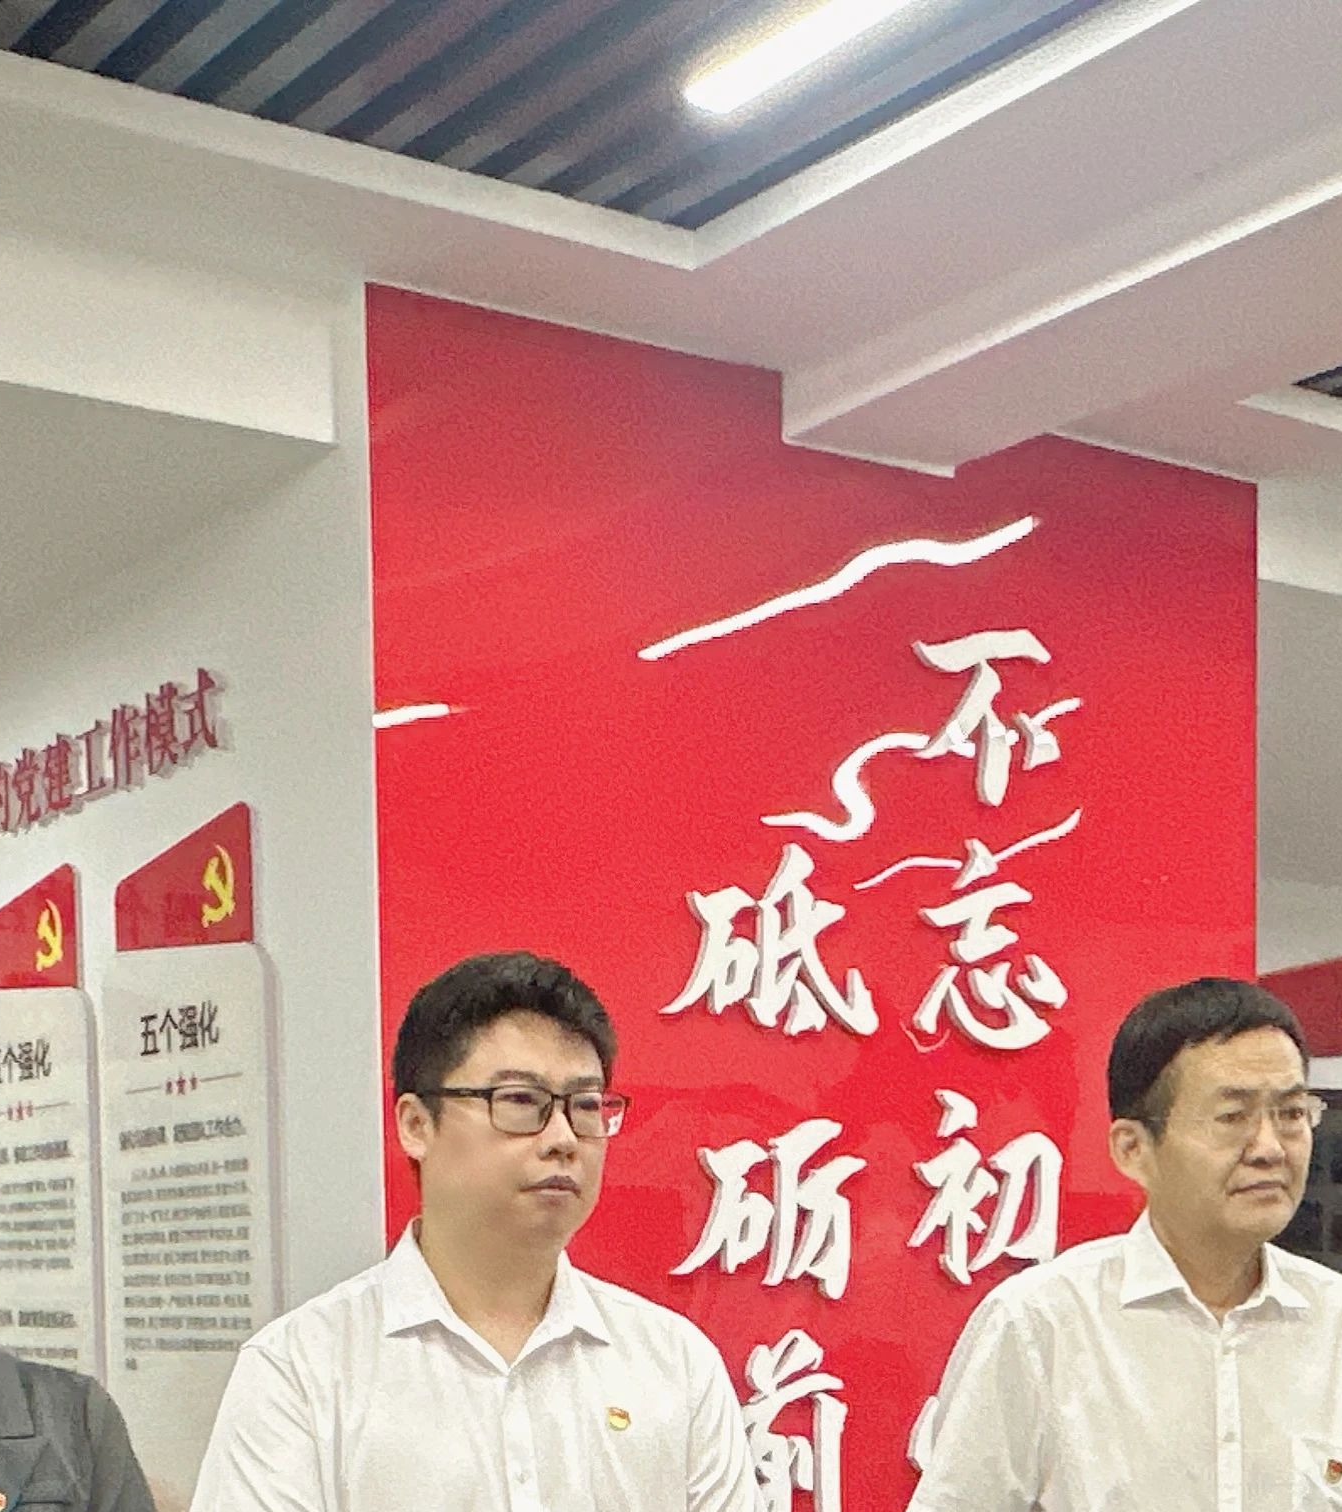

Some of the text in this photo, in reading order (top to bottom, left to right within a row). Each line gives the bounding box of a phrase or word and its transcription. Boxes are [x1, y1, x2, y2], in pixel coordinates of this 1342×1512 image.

[139, 1000, 220, 1056] 五个强化
[907, 628, 1069, 1472] 不忘初
